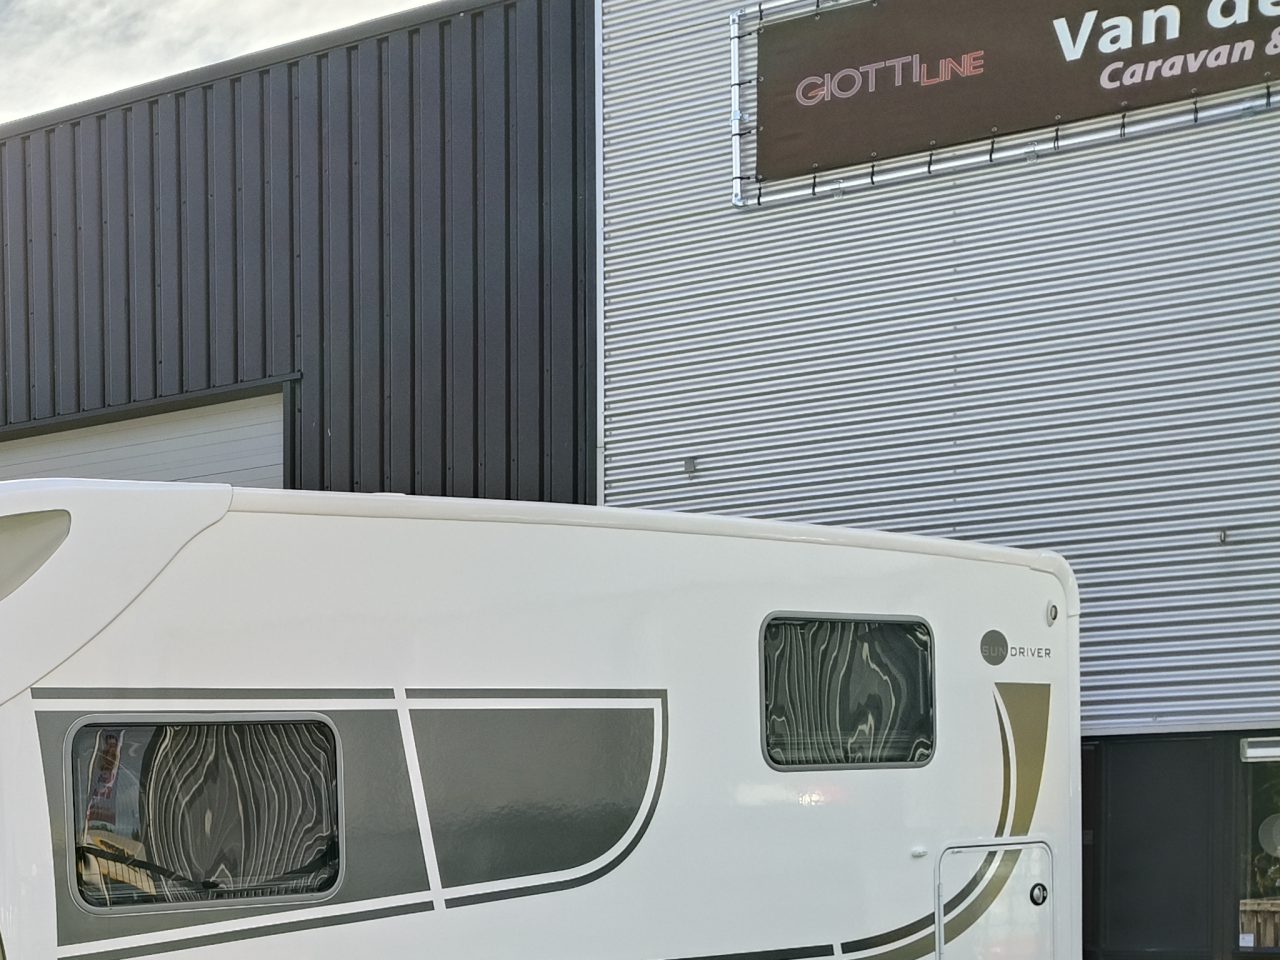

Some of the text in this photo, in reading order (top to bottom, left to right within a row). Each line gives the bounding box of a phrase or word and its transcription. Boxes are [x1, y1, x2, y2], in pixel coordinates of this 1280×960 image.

[1052, 4, 1181, 62] Van
[1099, 39, 1255, 89] Caravan
[982, 645, 1051, 658] SUN DRIVER
